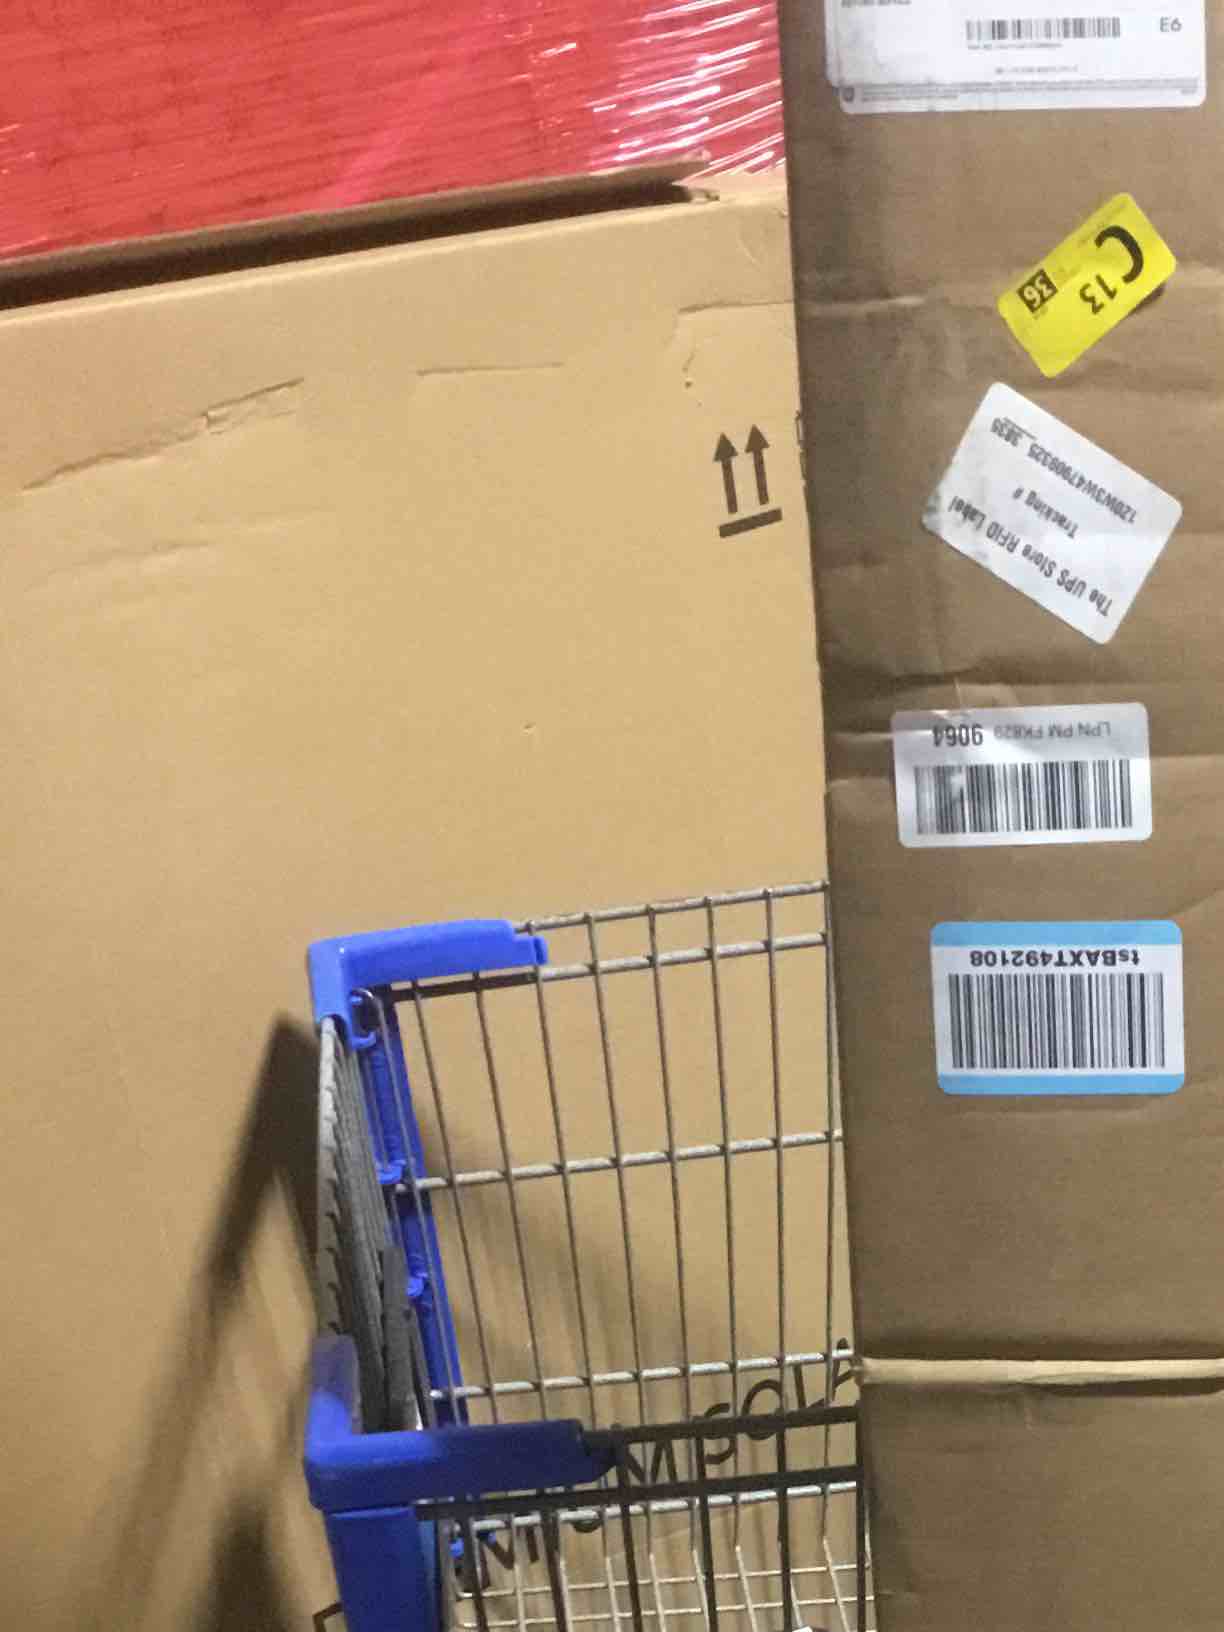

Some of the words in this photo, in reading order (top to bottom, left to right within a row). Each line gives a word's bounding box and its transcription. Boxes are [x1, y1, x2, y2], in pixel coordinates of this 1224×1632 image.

[1160, 17, 1182, 33] E6
[1096, 224, 1144, 284] C
[1081, 272, 1118, 315] 13
[949, 496, 986, 531] Label
[1025, 491, 1078, 539] Tracking
[986, 521, 1020, 553] RFID
[1022, 544, 1057, 578] Store
[1056, 569, 1087, 598] UPS
[1089, 589, 1113, 616] The
[932, 722, 984, 748] 9064
[969, 949, 1140, 967] tsBAXT492108
